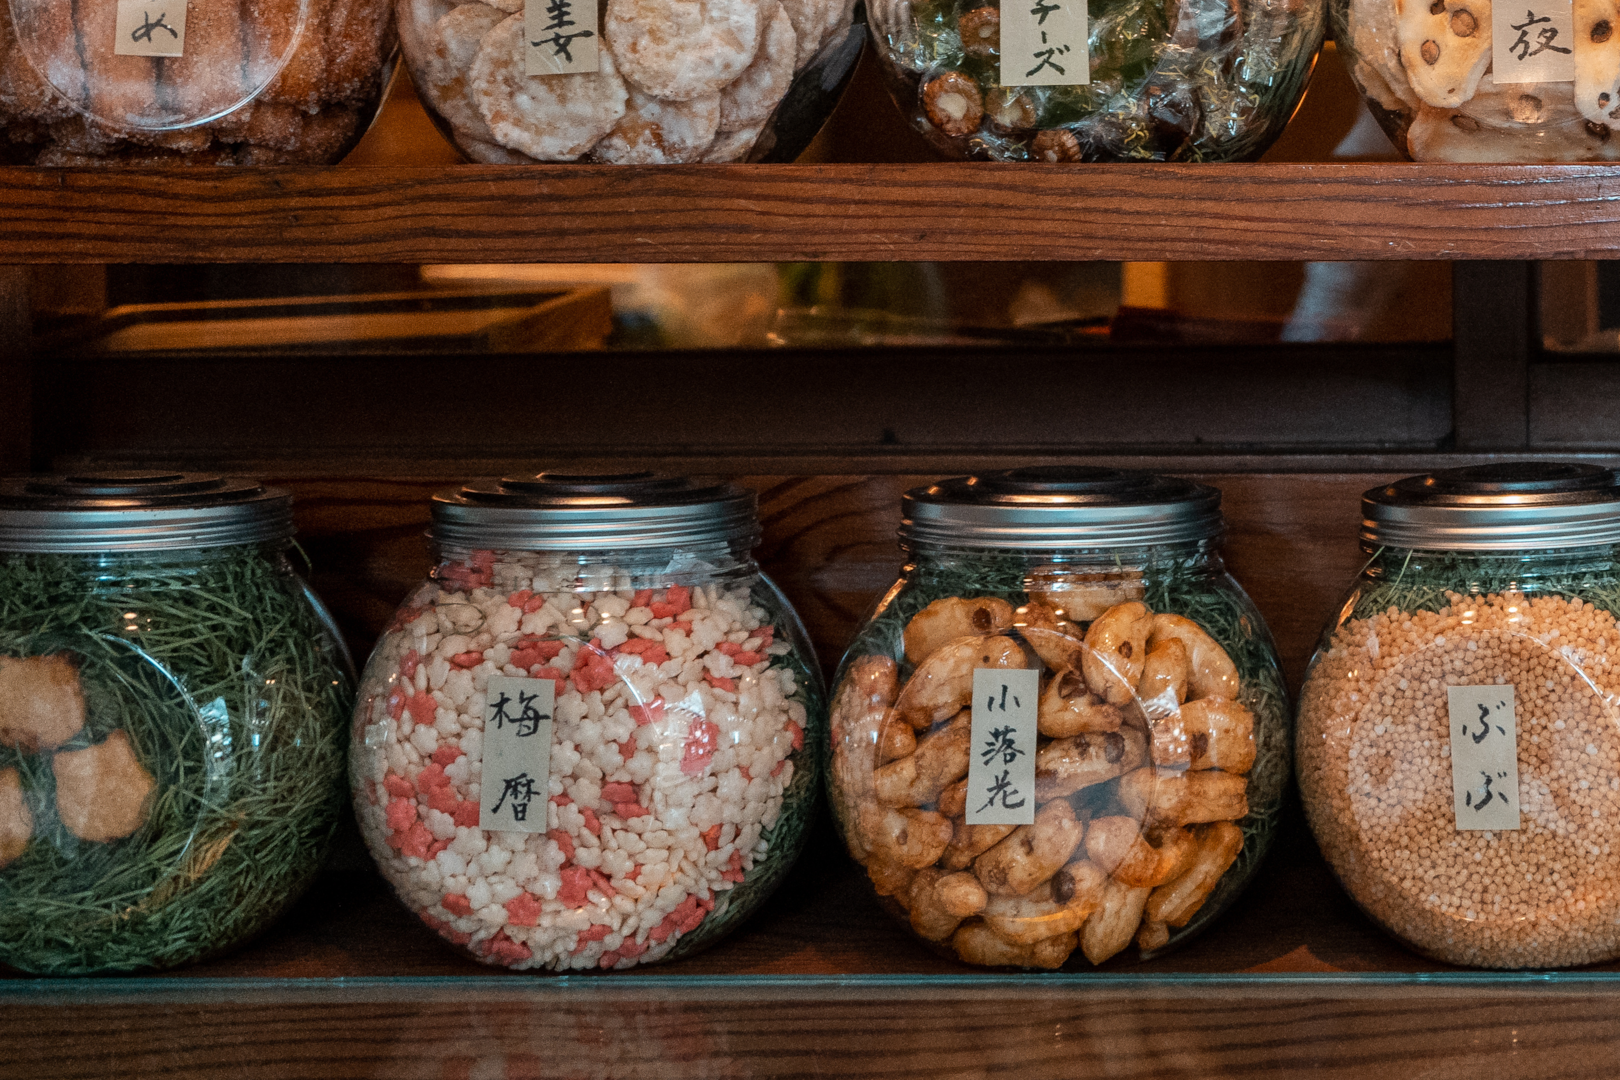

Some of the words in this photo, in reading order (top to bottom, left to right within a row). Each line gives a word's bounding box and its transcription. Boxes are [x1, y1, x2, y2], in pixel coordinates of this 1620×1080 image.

[489, 690, 551, 821] 梅暦
[976, 684, 1026, 813] 小落花
[1462, 700, 1508, 812] ぶぶ
